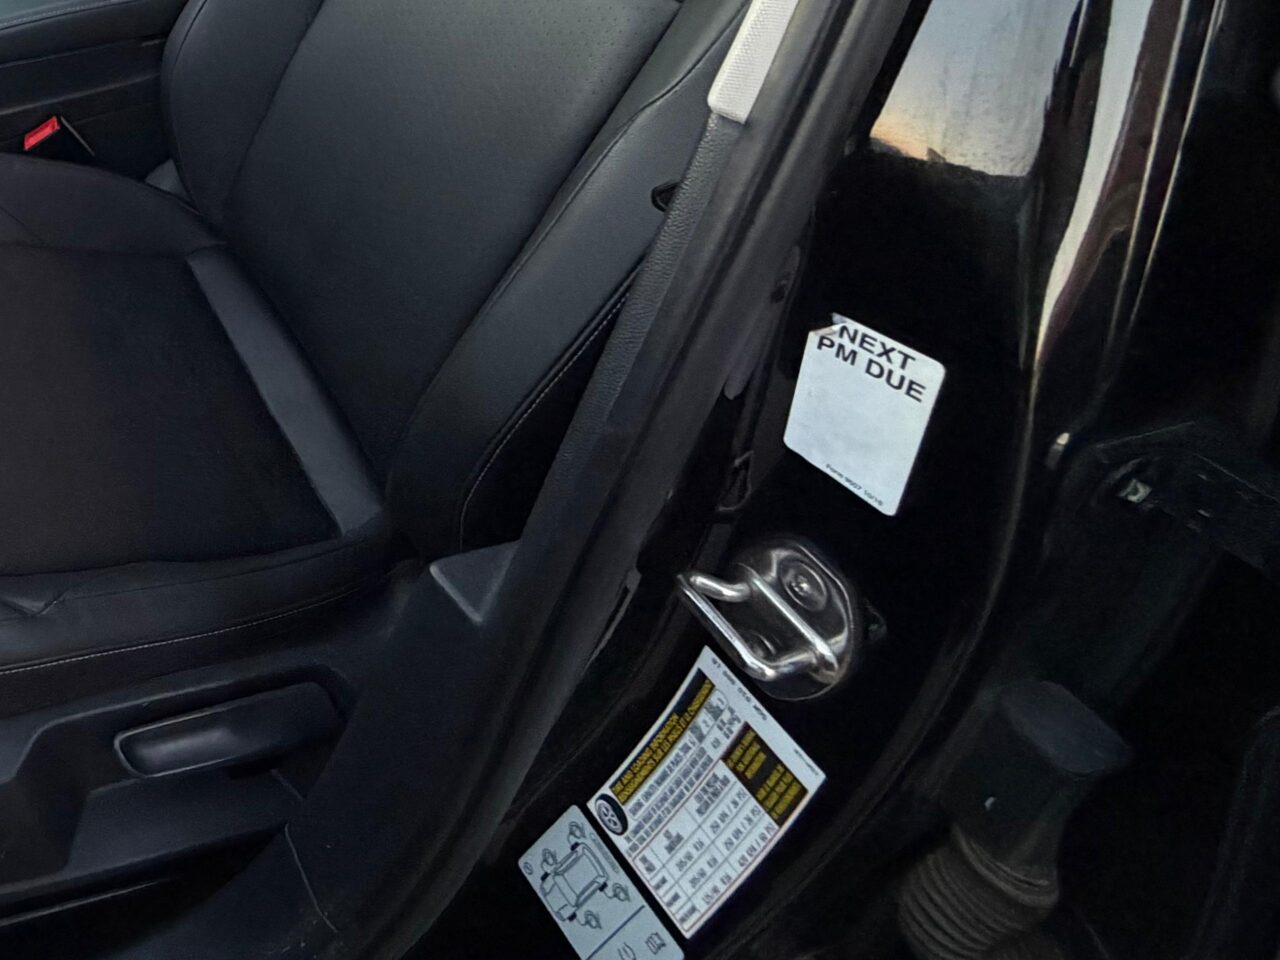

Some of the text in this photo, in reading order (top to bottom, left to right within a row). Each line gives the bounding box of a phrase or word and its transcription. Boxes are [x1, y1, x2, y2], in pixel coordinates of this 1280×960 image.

[817, 336, 927, 404] PM DUE
[839, 325, 916, 371] NEXT
